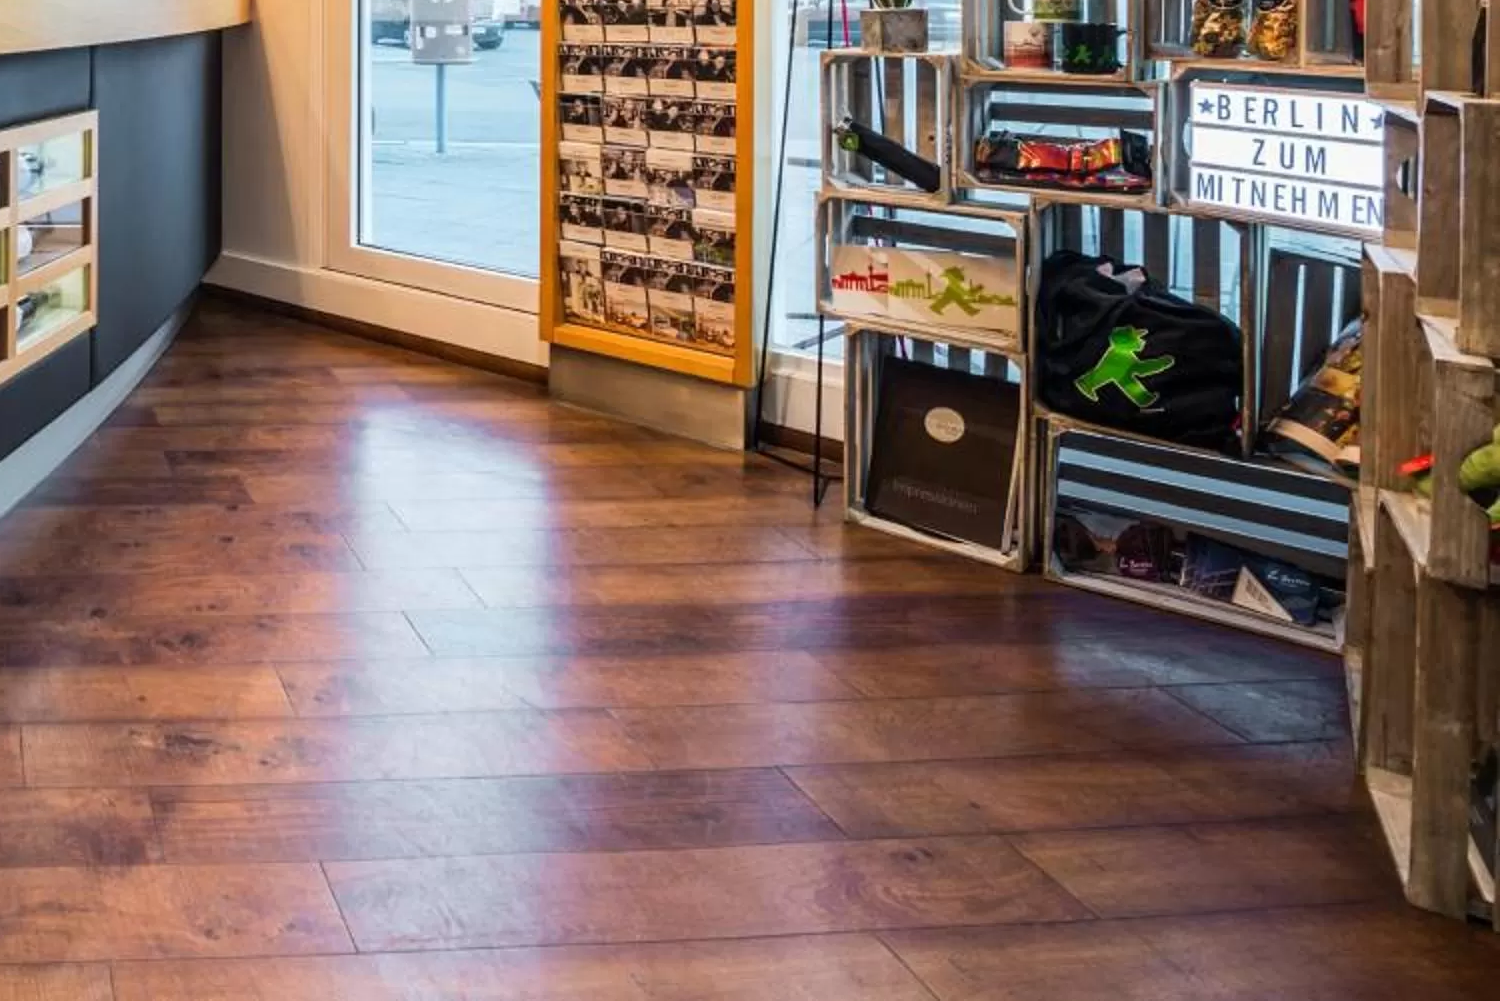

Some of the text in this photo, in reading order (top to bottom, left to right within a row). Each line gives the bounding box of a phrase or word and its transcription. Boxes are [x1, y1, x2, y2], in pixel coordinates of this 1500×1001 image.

[1217, 94, 1360, 134] BERLIN
[1252, 138, 1327, 175] ZUM
[1197, 172, 1384, 226] MITNEHMEN
